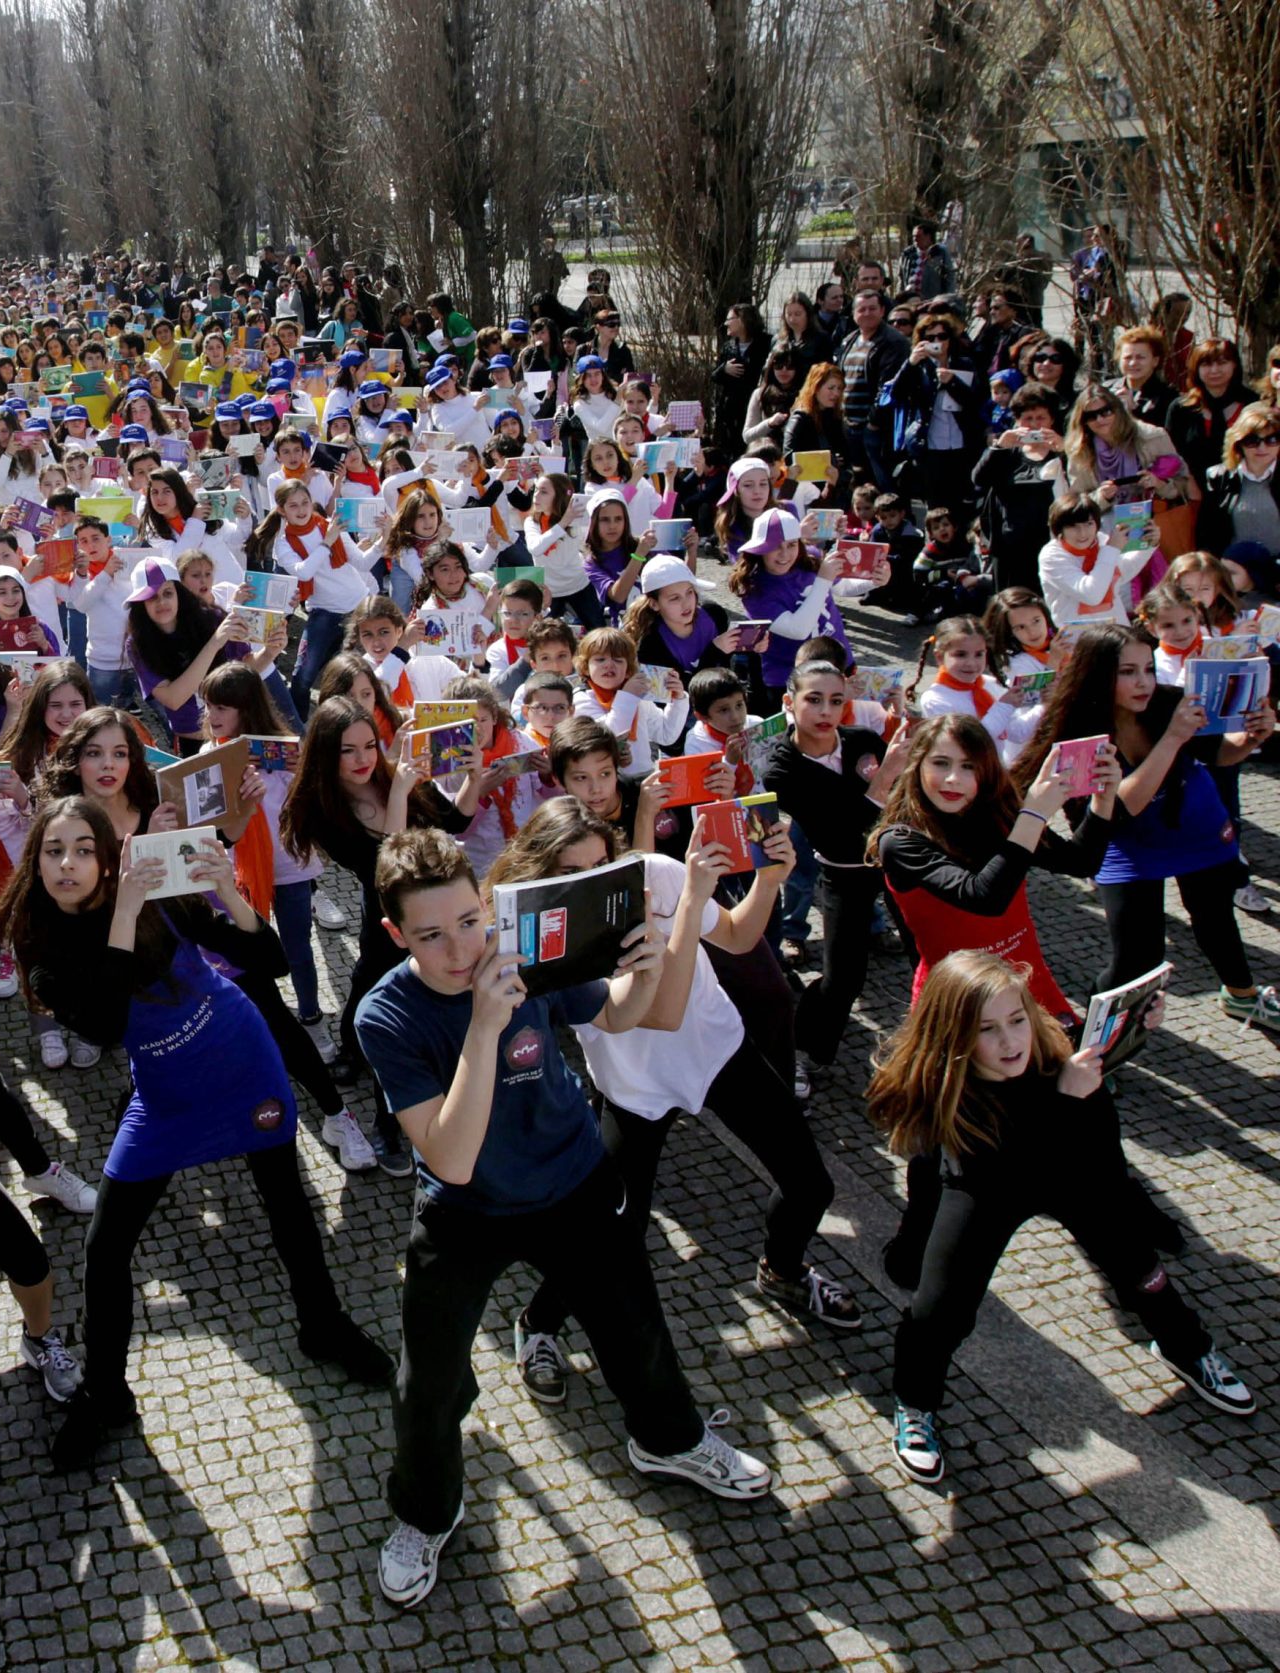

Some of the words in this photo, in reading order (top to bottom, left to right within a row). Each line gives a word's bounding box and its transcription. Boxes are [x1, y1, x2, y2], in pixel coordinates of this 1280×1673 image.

[140, 1031, 182, 1051] ACADEMIA
[182, 1020, 194, 1033] DE
[152, 1048, 165, 1057] DE
[166, 1010, 214, 1053] MATOSINHOS
